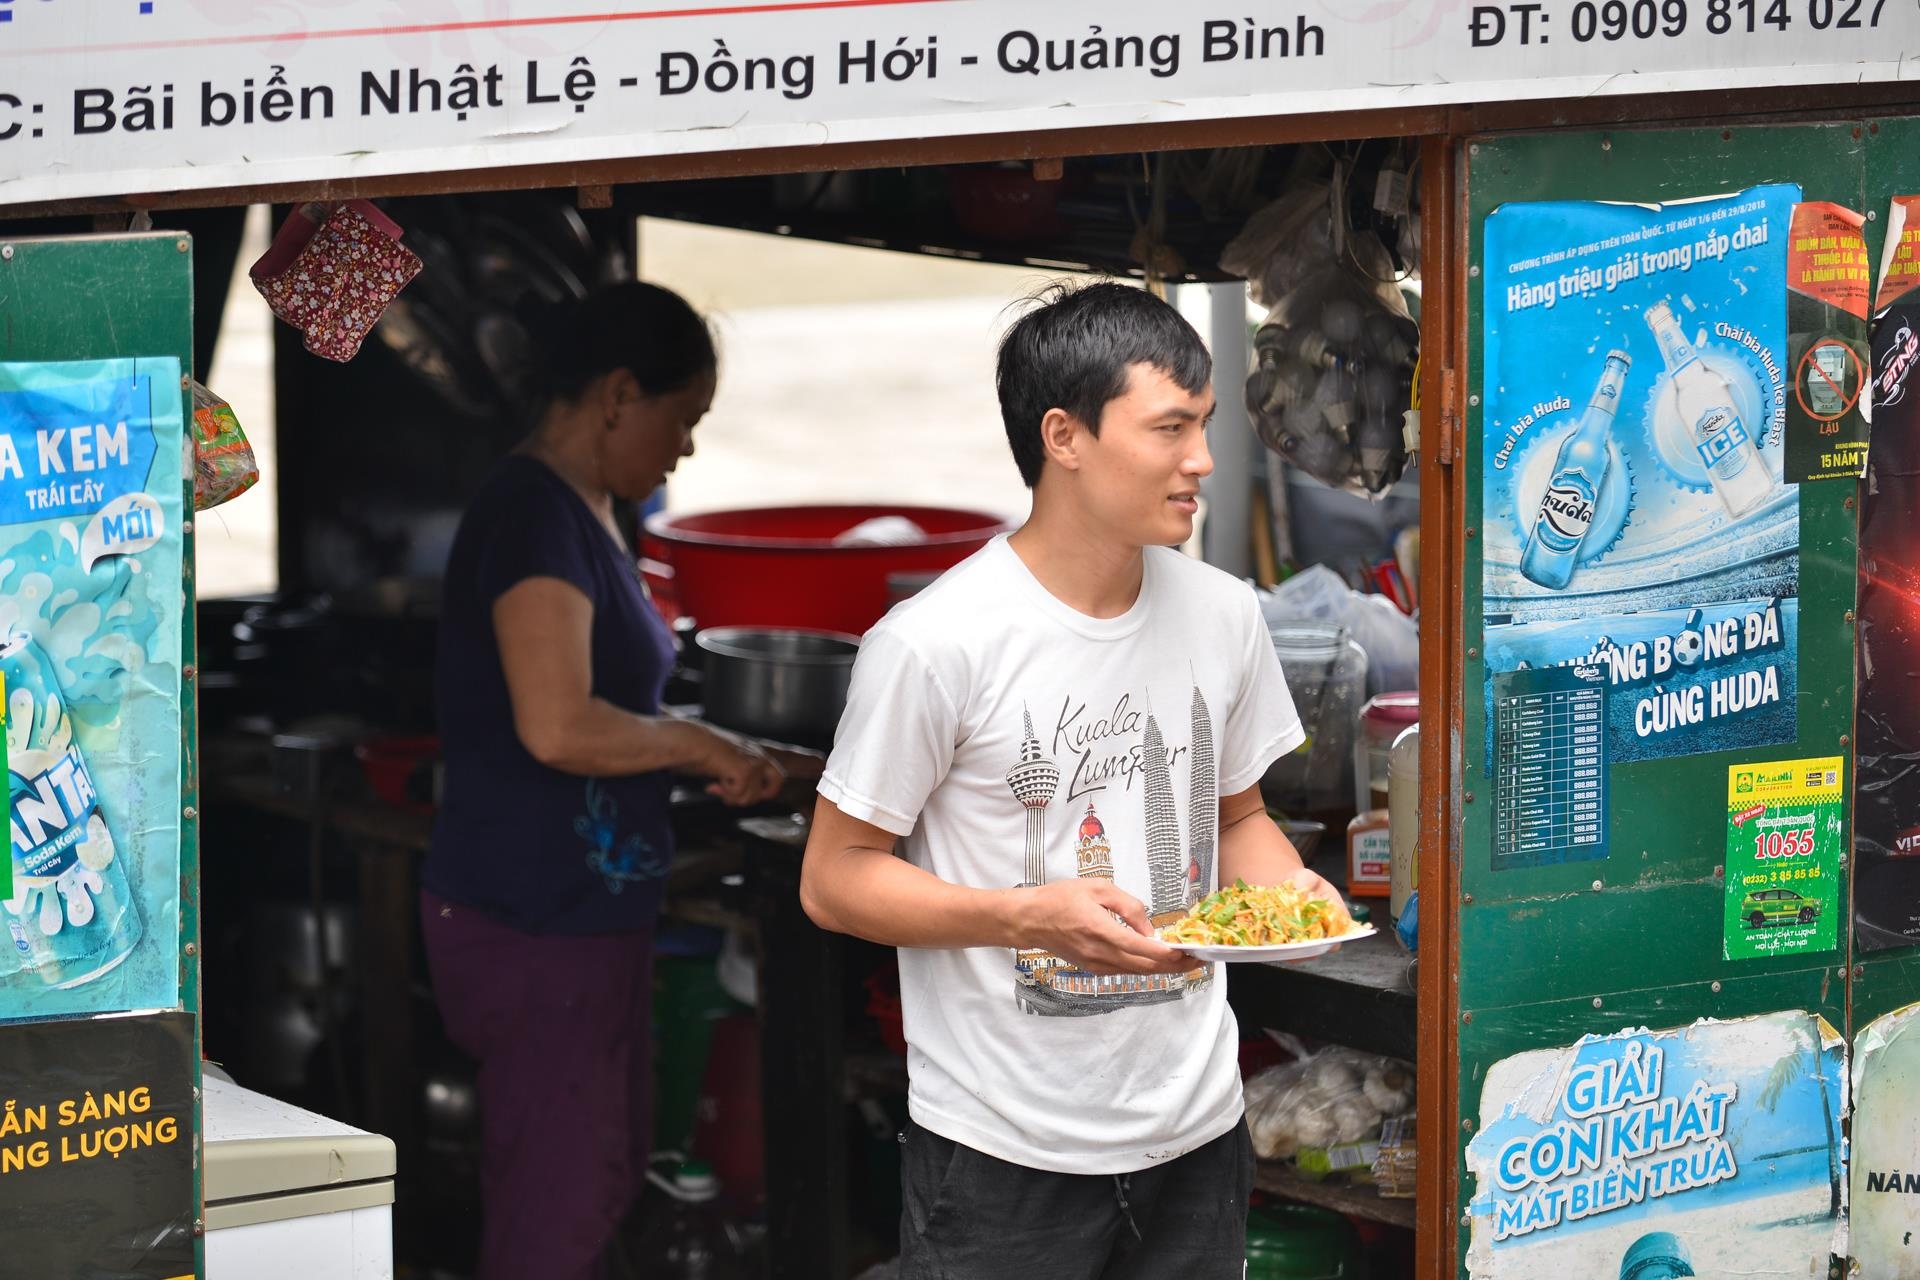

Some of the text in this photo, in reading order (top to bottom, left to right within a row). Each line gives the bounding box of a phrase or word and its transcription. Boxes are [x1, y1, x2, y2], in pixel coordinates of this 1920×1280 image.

[1468, 0, 1886, 47] ĐT: 0909 814 027
[73, 84, 174, 135] Bãi
[201, 65, 334, 127] biển
[361, 63, 503, 121] Nhật
[527, 57, 597, 113] Lệ
[656, 38, 815, 99] Đồng
[838, 36, 939, 85] Hới
[998, 26, 1181, 78] Quảng
[1203, 16, 1326, 63] Bình
[1566, 247, 1577, 259] ÁP
[1727, 199, 1766, 217] 29/8/2018
[1507, 217, 1768, 312] Hàng triệu giải trong nắp chai
[1715, 321, 1786, 447] Chai bia Huda Ice Blast
[1882, 331, 1919, 393] STING
[37, 421, 129, 475] KEM
[1493, 395, 1571, 470] Chai bia Huda
[1700, 420, 1746, 466] ICE
[1820, 421, 1840, 436] LẬU
[1820, 454, 1832, 469] 15
[1833, 450, 1859, 468] NĂM
[26, 479, 105, 510] TRÁI CÂY
[102, 502, 155, 545] MỚI
[1744, 598, 1780, 651] ĐÁ
[1053, 692, 1142, 756] Kuala
[1635, 665, 1780, 737] CÙNG HUDA
[1066, 745, 1187, 803] Lumpr
[24, 826, 82, 868] Soda Kem
[1754, 828, 1815, 860] 1055
[1743, 874, 1768, 886] (0232)
[1770, 872, 1777, 882] 3
[1794, 869, 1806, 879] 85
[1808, 868, 1820, 878] 85
[1565, 1041, 1660, 1115] GIẢI
[58, 1086, 151, 1126] SÀNG
[61, 1117, 178, 1162] LƯỢNG
[1497, 1082, 1736, 1190] CƠN KHÁT
[1495, 1140, 1738, 1238] MÁT BIỂN TRƯA
